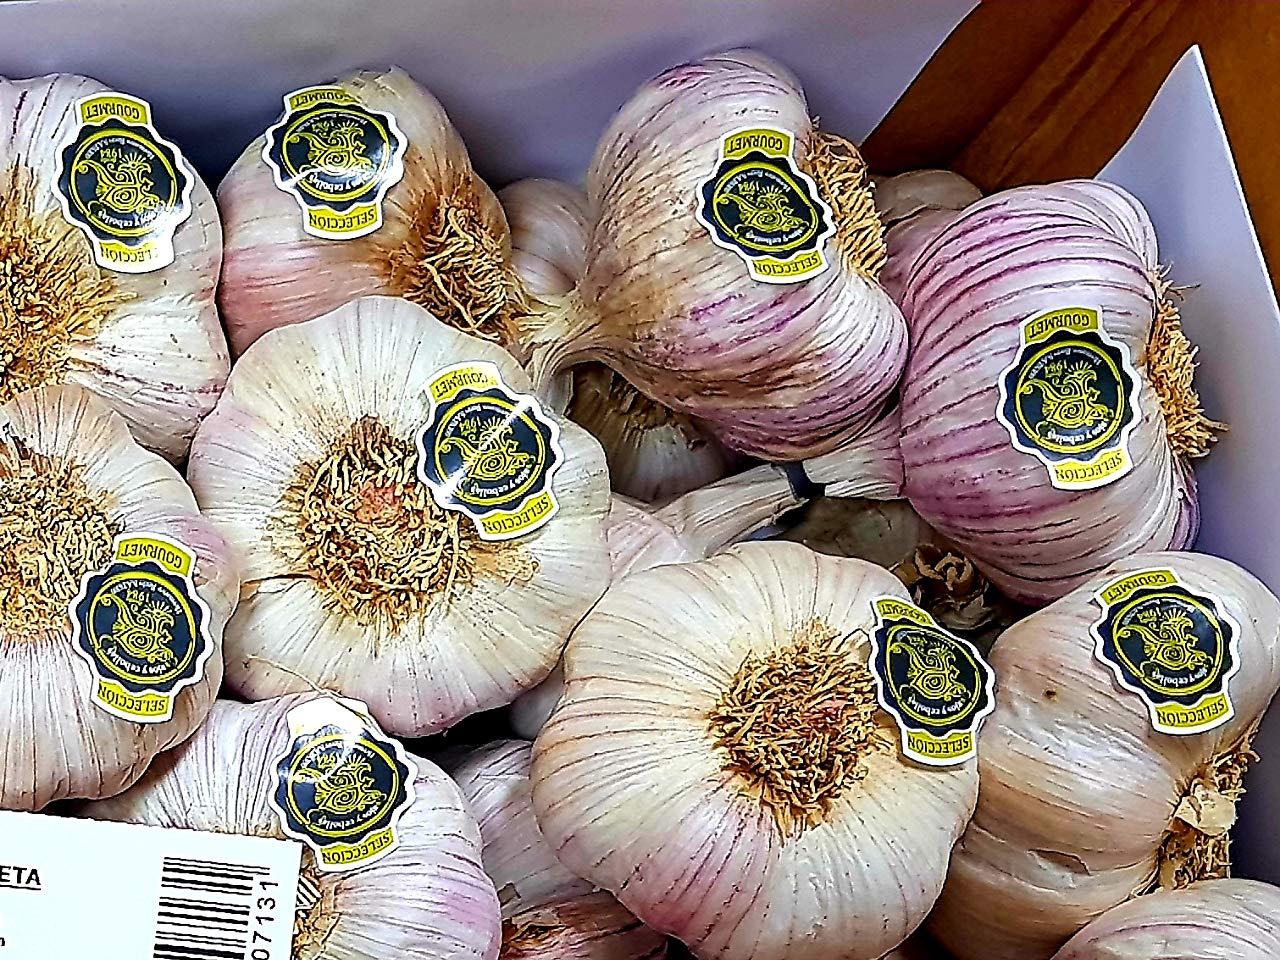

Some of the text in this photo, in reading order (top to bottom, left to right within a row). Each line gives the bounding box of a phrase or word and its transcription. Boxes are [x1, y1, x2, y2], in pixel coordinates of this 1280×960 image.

[86, 103, 140, 120] GOURMET
[728, 136, 782, 153] GOURMET
[100, 246, 152, 263] LECCIÓN
[1030, 314, 1089, 337] GOURMET
[121, 544, 182, 568] GOURMET
[1107, 575, 1166, 599] GOURMET
